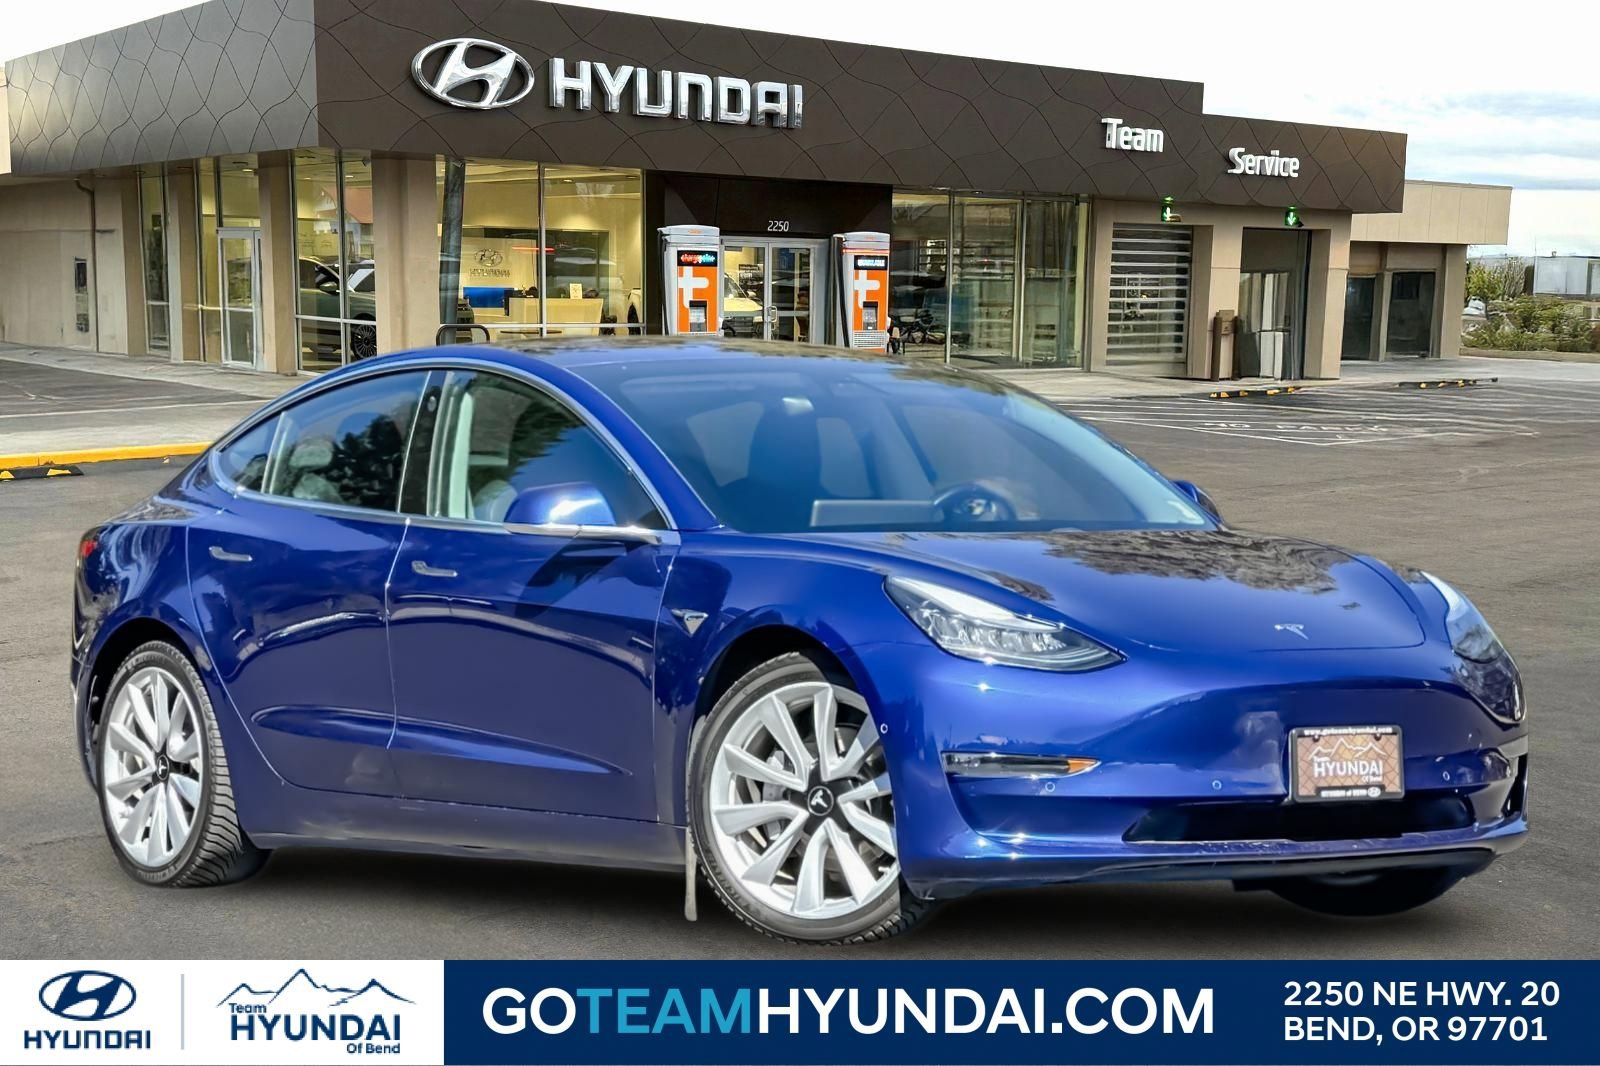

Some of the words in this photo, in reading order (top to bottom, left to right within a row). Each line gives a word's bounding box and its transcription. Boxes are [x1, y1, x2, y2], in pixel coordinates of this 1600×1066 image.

[549, 57, 803, 129] HYUNDAI
[1101, 117, 1164, 152] Team
[1227, 147, 1300, 177] Service
[767, 220, 790, 232] 2250
[1314, 760, 1383, 778] HYUNDAI
